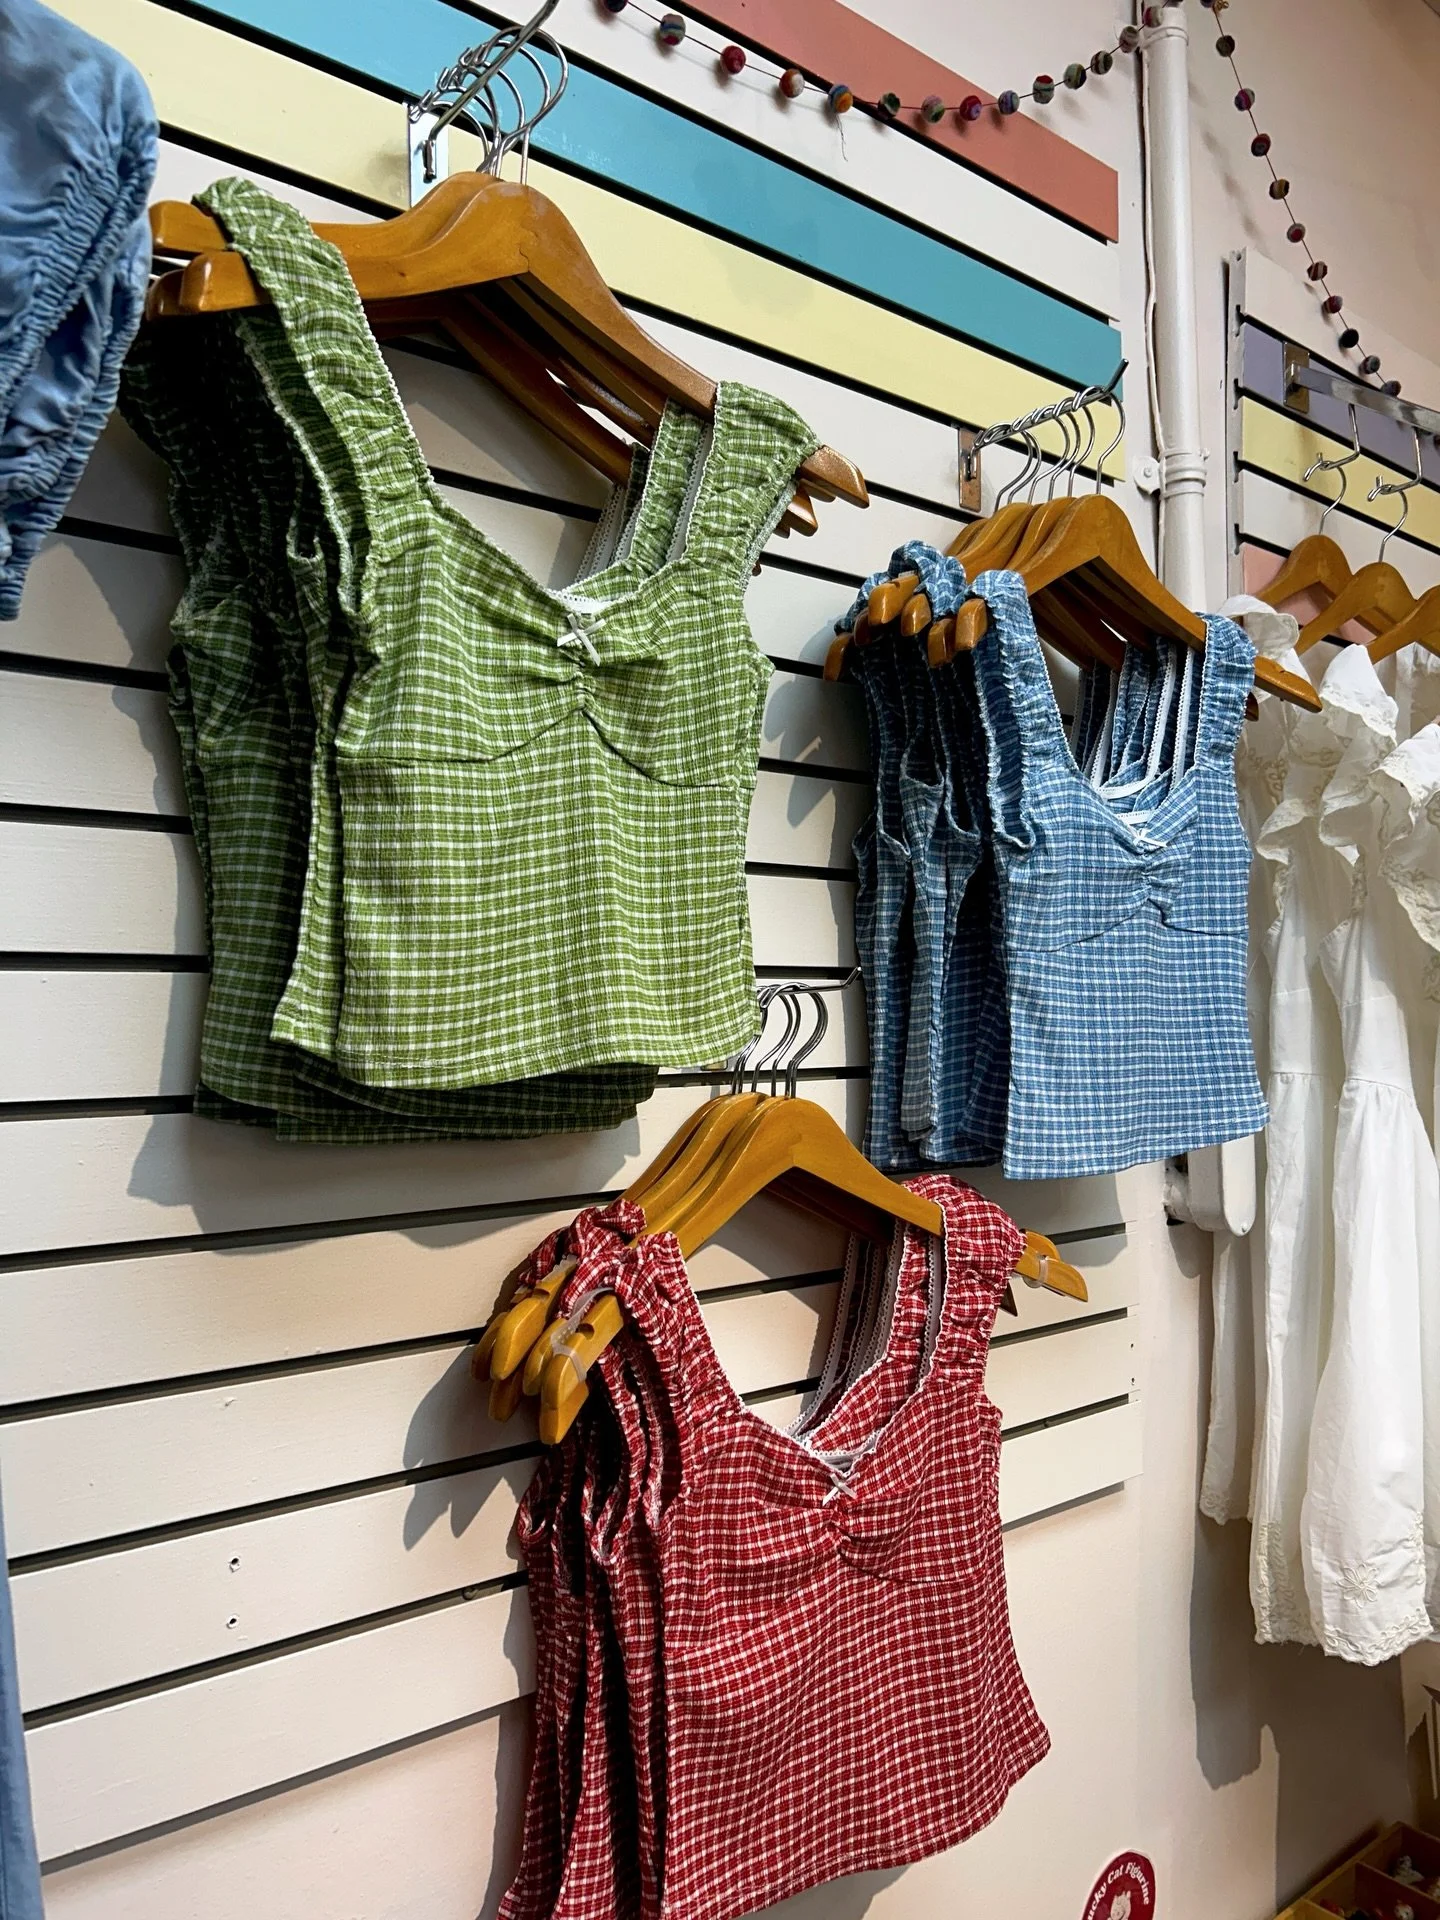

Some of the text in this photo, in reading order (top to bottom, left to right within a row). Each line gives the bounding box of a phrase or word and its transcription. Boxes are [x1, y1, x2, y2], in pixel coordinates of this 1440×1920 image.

[1087, 1862, 1149, 1920] ucky Cat Figurine
